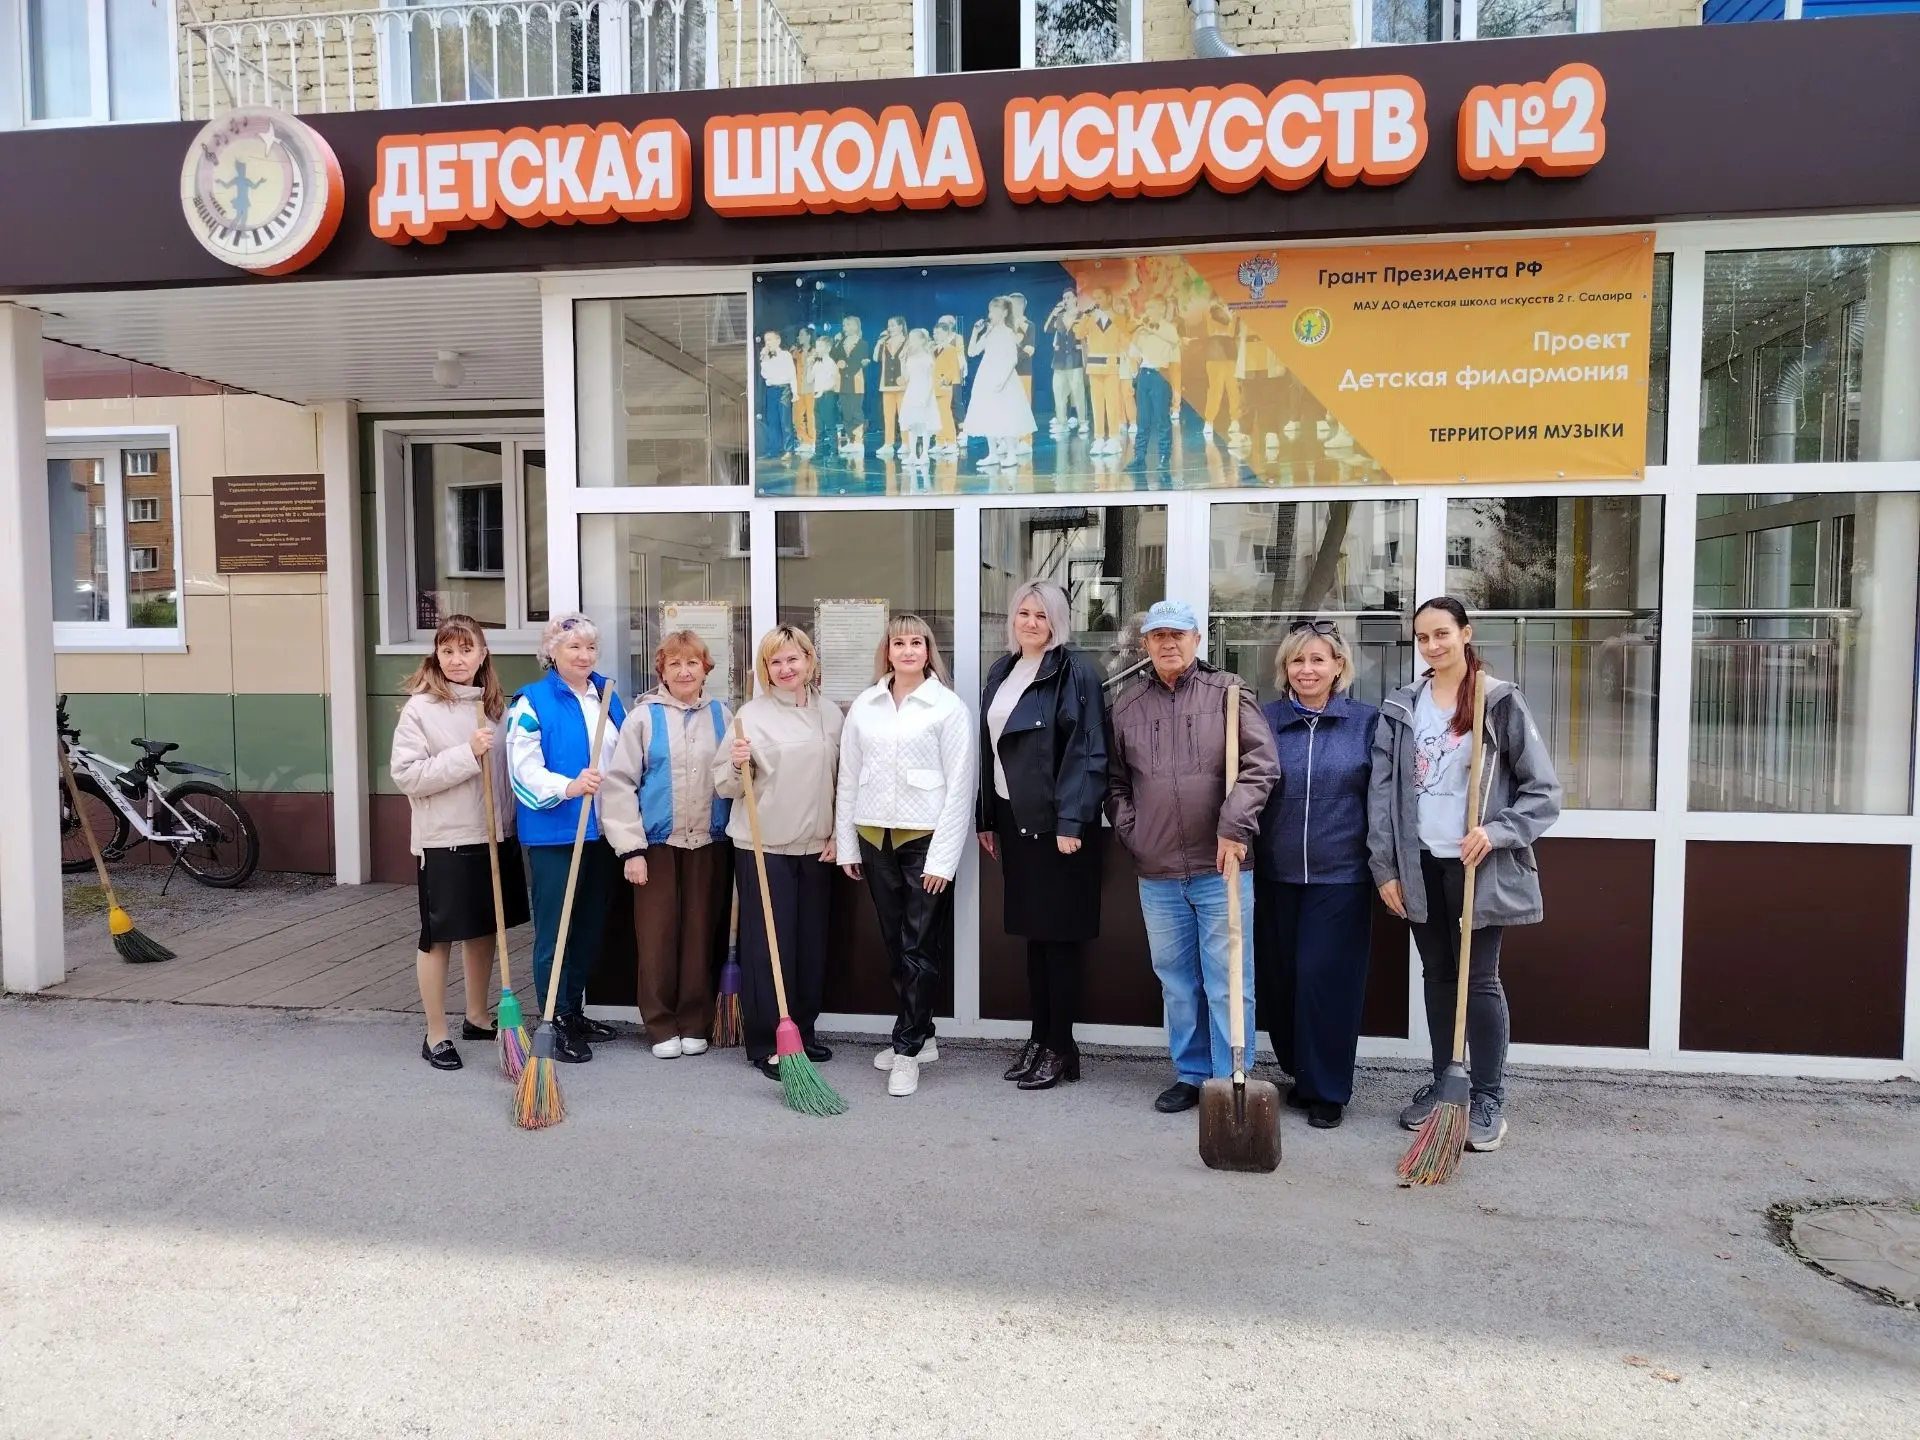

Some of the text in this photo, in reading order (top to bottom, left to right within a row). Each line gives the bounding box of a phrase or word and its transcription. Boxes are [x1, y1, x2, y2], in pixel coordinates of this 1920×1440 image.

[377, 76, 1598, 226] ДЕТСКАЯ ШКОЛА ИСКУССТВ №2
[1318, 260, 1543, 289] Грант Президента РФ
[1353, 292, 1632, 312] МАУ ДО «Детская школа искусств 2 г. Салаира
[1533, 331, 1631, 355] Проект
[1338, 364, 1629, 392] Детская филармония
[1430, 423, 1624, 443] ТЕРРИТОРИЯ МУЗЫКИ
